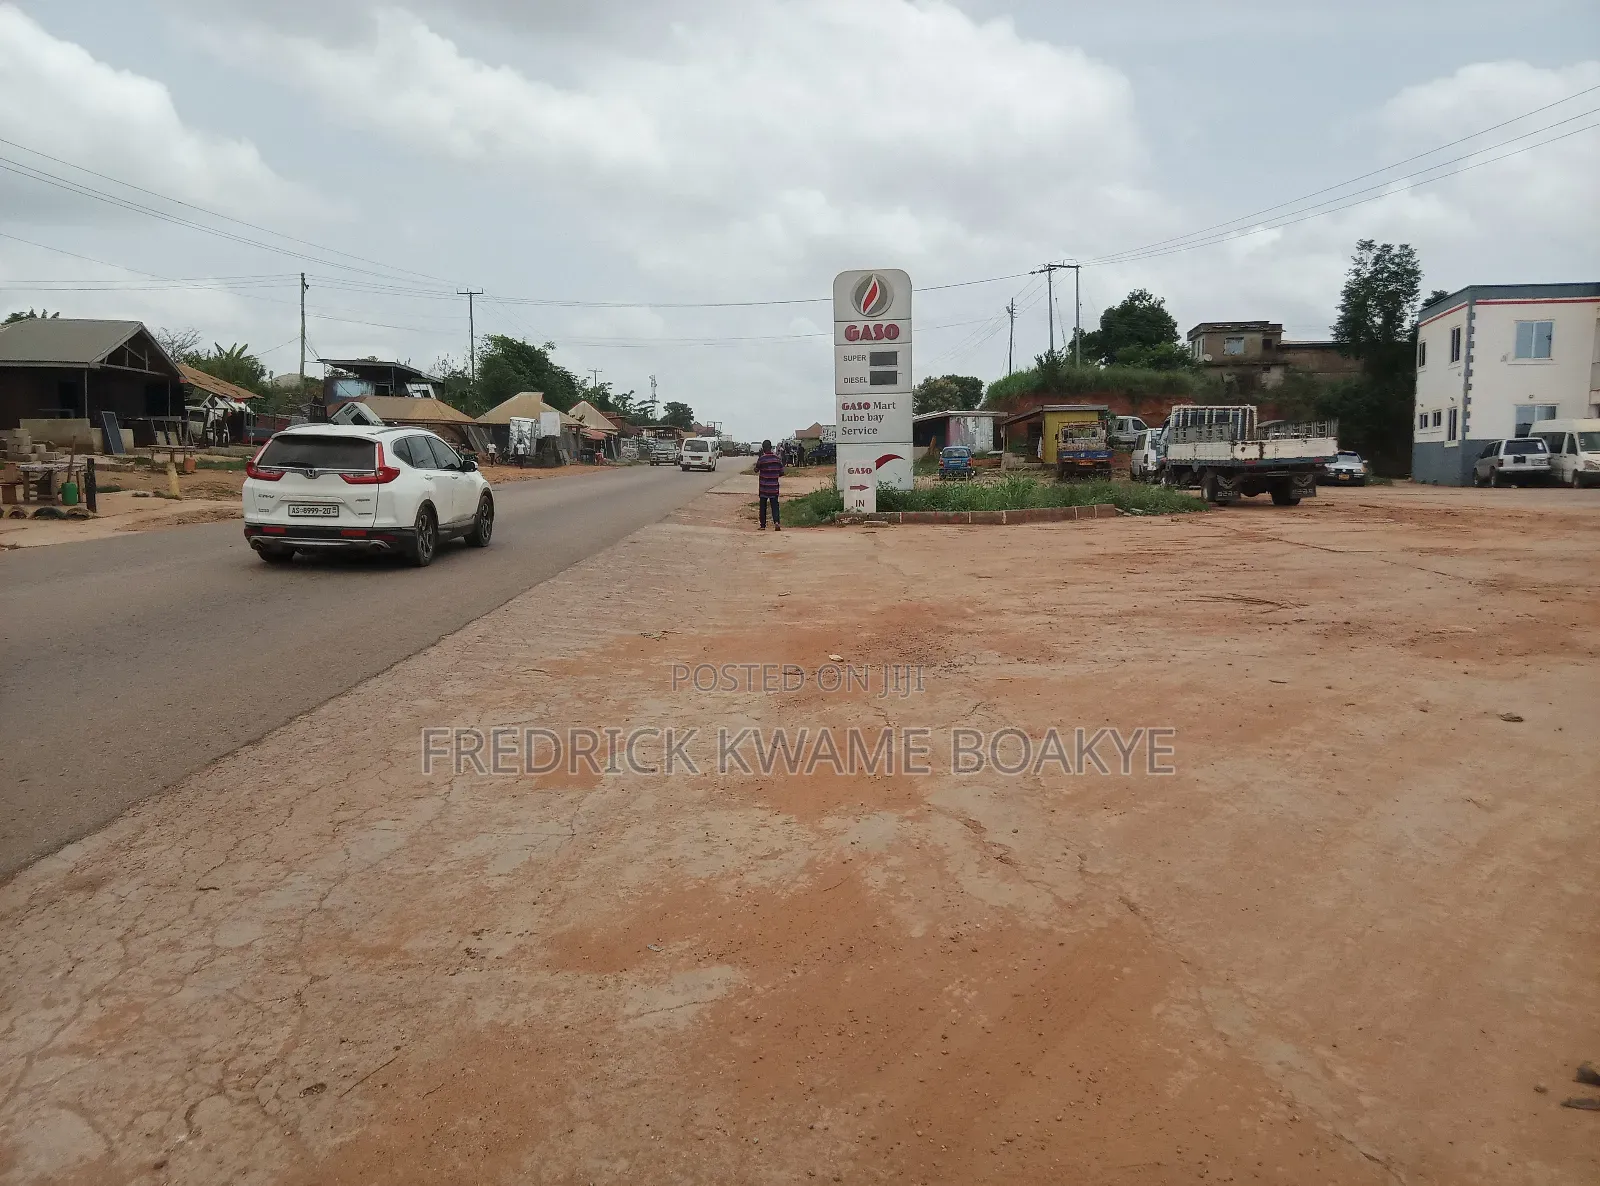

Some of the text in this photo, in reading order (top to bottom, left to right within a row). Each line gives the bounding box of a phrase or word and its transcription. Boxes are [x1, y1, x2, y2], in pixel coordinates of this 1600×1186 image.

[844, 323, 900, 342] GASO
[843, 354, 867, 362] SUPER
[843, 376, 868, 384] DIESEL
[841, 401, 896, 411] GASO Mart
[841, 412, 884, 423] Lube bay
[841, 426, 878, 436] Service
[847, 467, 873, 475] GASO
[855, 499, 865, 508] IN
